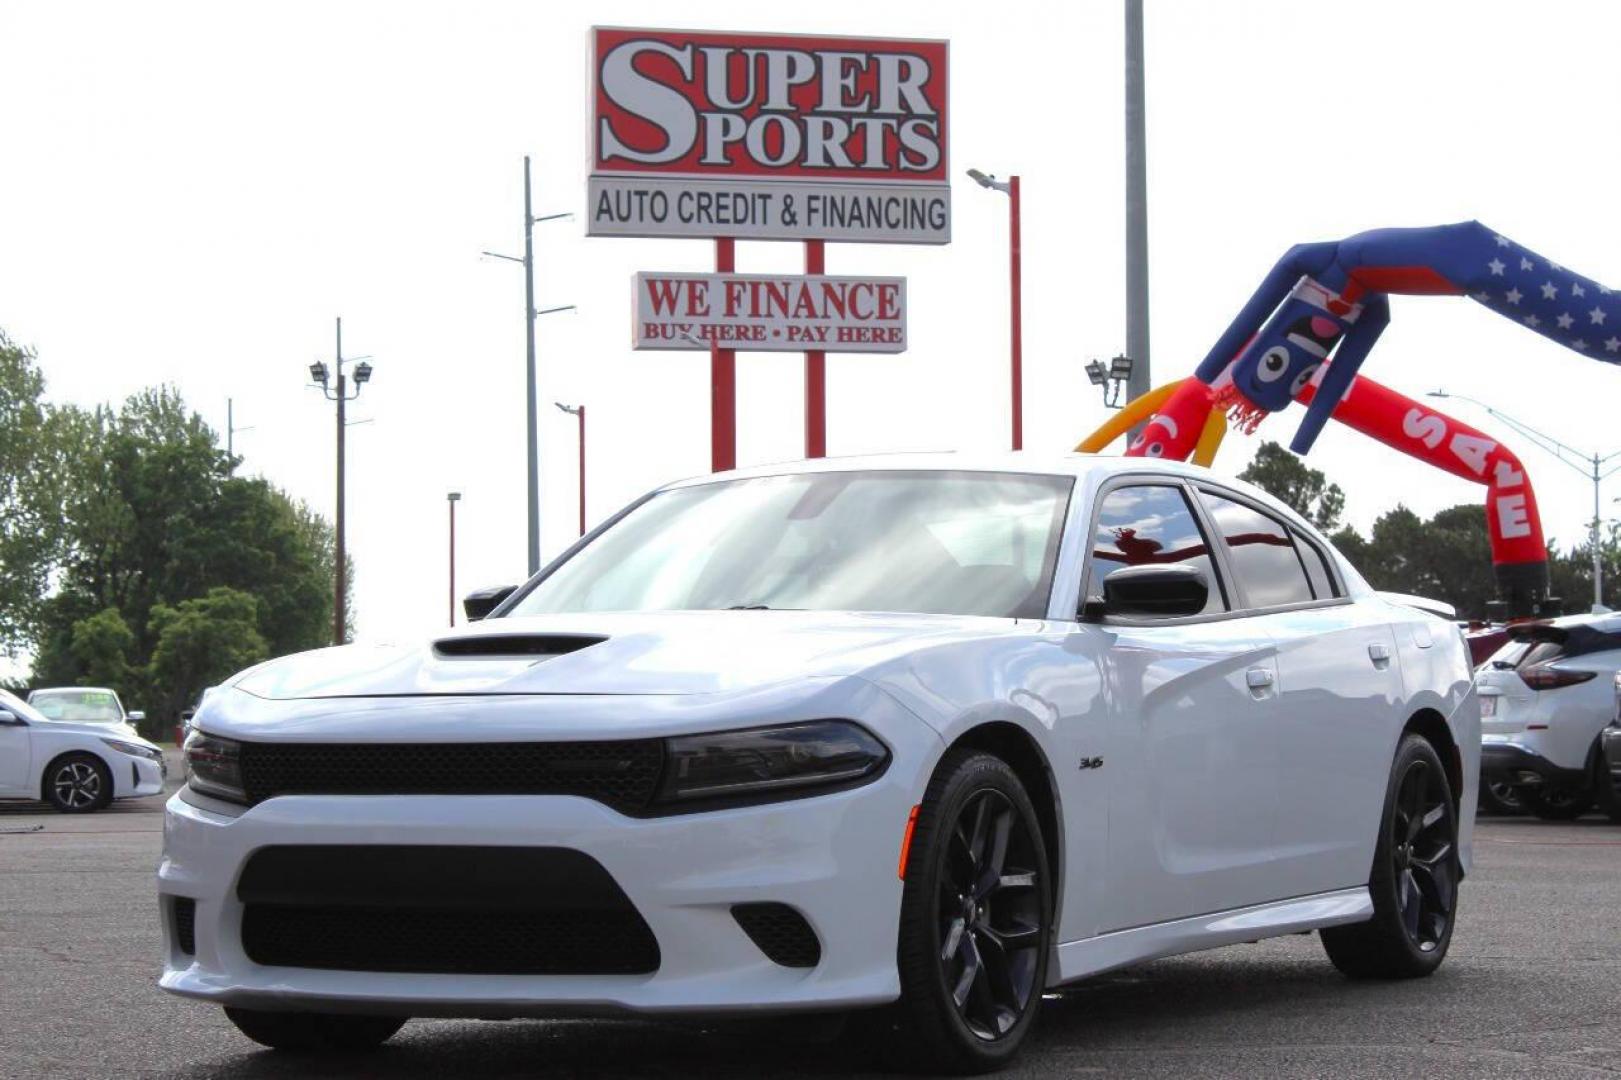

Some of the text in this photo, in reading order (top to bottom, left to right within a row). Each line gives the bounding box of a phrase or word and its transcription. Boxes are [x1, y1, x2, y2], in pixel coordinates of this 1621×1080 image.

[602, 38, 937, 164] SUPER
[596, 189, 946, 230] AUTO CREDIT & FINANCING
[645, 279, 900, 320] WE FINANCE
[643, 322, 902, 344] BUY HERE PAY HERE
[1402, 408, 1531, 539] SALE
